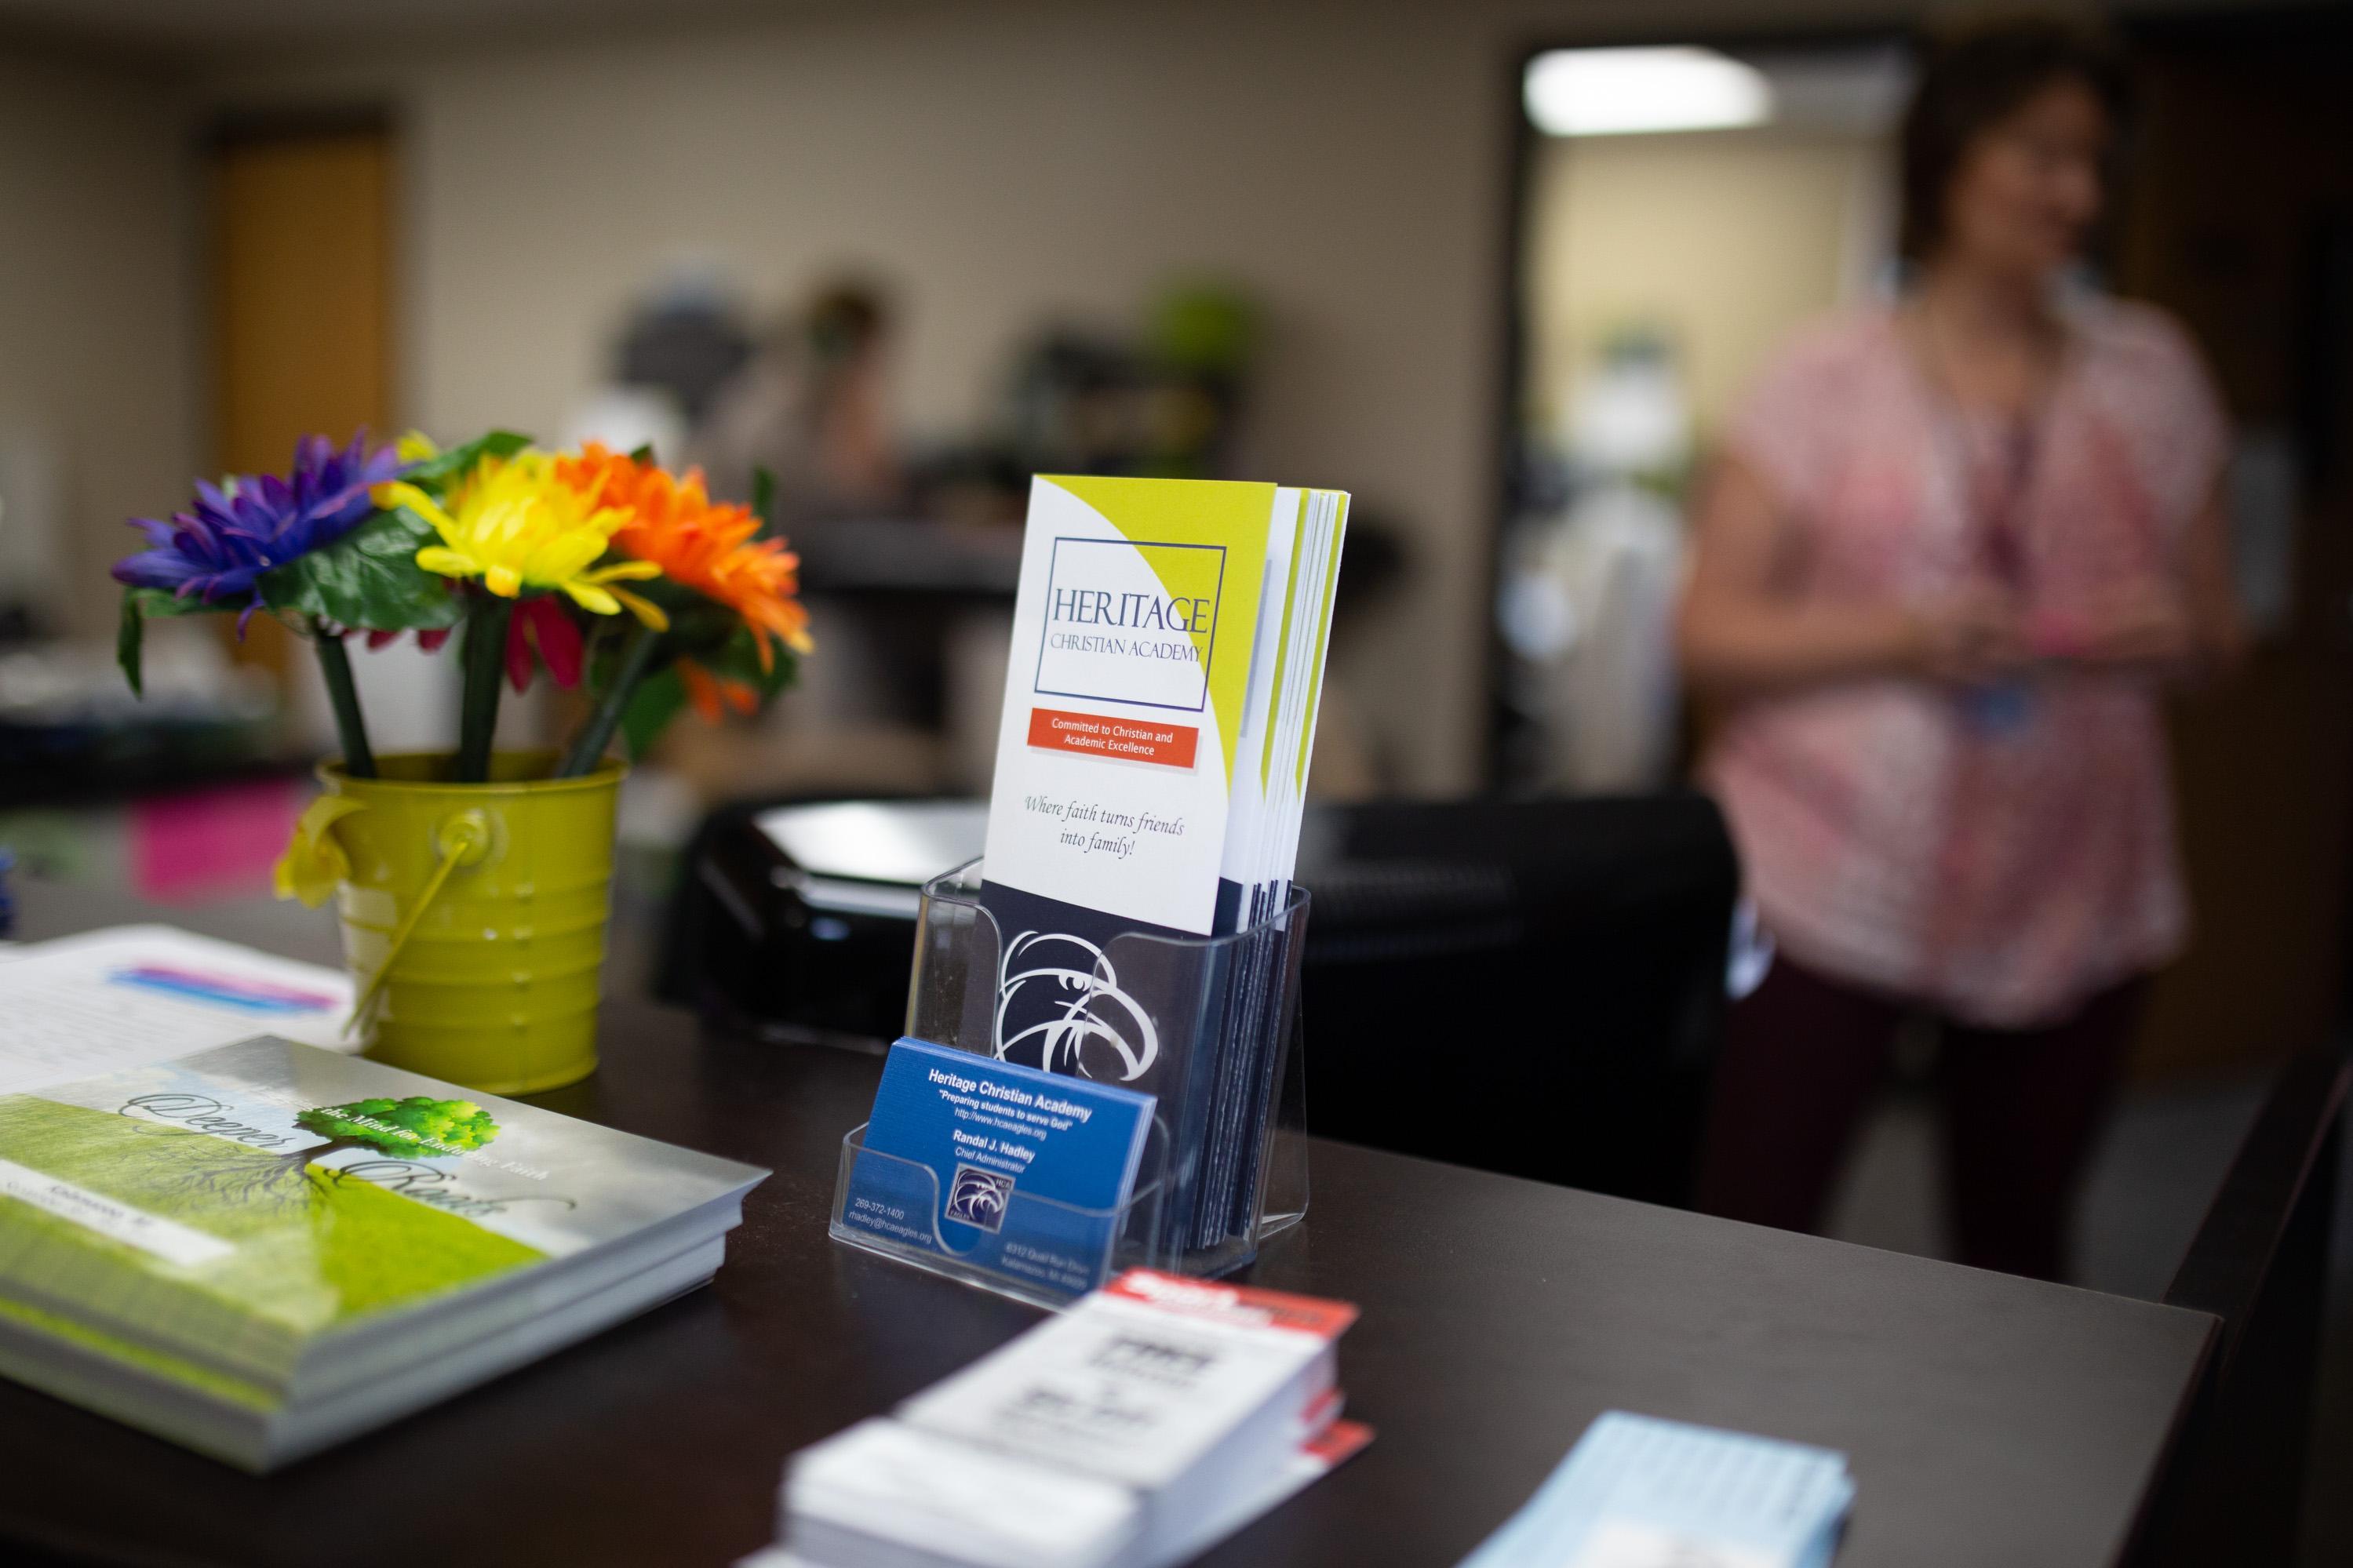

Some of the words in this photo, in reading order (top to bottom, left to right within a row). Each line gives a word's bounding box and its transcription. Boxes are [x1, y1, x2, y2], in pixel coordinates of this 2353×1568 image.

[1052, 588, 1211, 634] HERITAGE
[1051, 633, 1127, 654] CHRISTIAN
[1128, 640, 1204, 663] ACADEMY
[1051, 718, 1100, 733] Committed
[1102, 725, 1110, 736] to
[1113, 725, 1153, 741] Christian
[1155, 732, 1173, 744] and
[1064, 734, 1105, 749] Academic
[1108, 739, 1155, 756] Excellence
[1025, 795, 1064, 817] Where
[1062, 800, 1098, 822] faith
[1100, 809, 1135, 828] turns
[1133, 812, 1186, 836] friends
[1060, 828, 1085, 847] into
[1084, 831, 1135, 860] family!
[928, 1068, 978, 1093] Heritage
[979, 1080, 1033, 1105] Christian
[1034, 1094, 1093, 1124] Academy
[939, 1089, 980, 1110] "Preparing
[981, 1101, 1015, 1118] students
[1017, 1109, 1026, 1120] to
[1026, 1114, 1049, 1126] serve
[1051, 1119, 1073, 1132] God"
[118, 1093, 297, 1148] Deeper
[319, 1108, 349, 1119] the
[346, 1115, 400, 1133] Mind
[392, 1129, 422, 1141] for
[418, 1136, 499, 1168] Endung
[954, 1107, 1047, 1142] http://www.hcaeagles.org
[952, 1128, 989, 1149] Randal
[989, 1140, 998, 1152] J.
[1000, 1141, 1036, 1164] Hadley
[955, 1146, 975, 1160] Chief
[975, 1151, 1026, 1173] Administrator
[996, 1178, 1011, 1188] HCA
[854, 1198, 905, 1220] 269-372-1400
[848, 1210, 933, 1245] rhadley@hcaeagles.org
